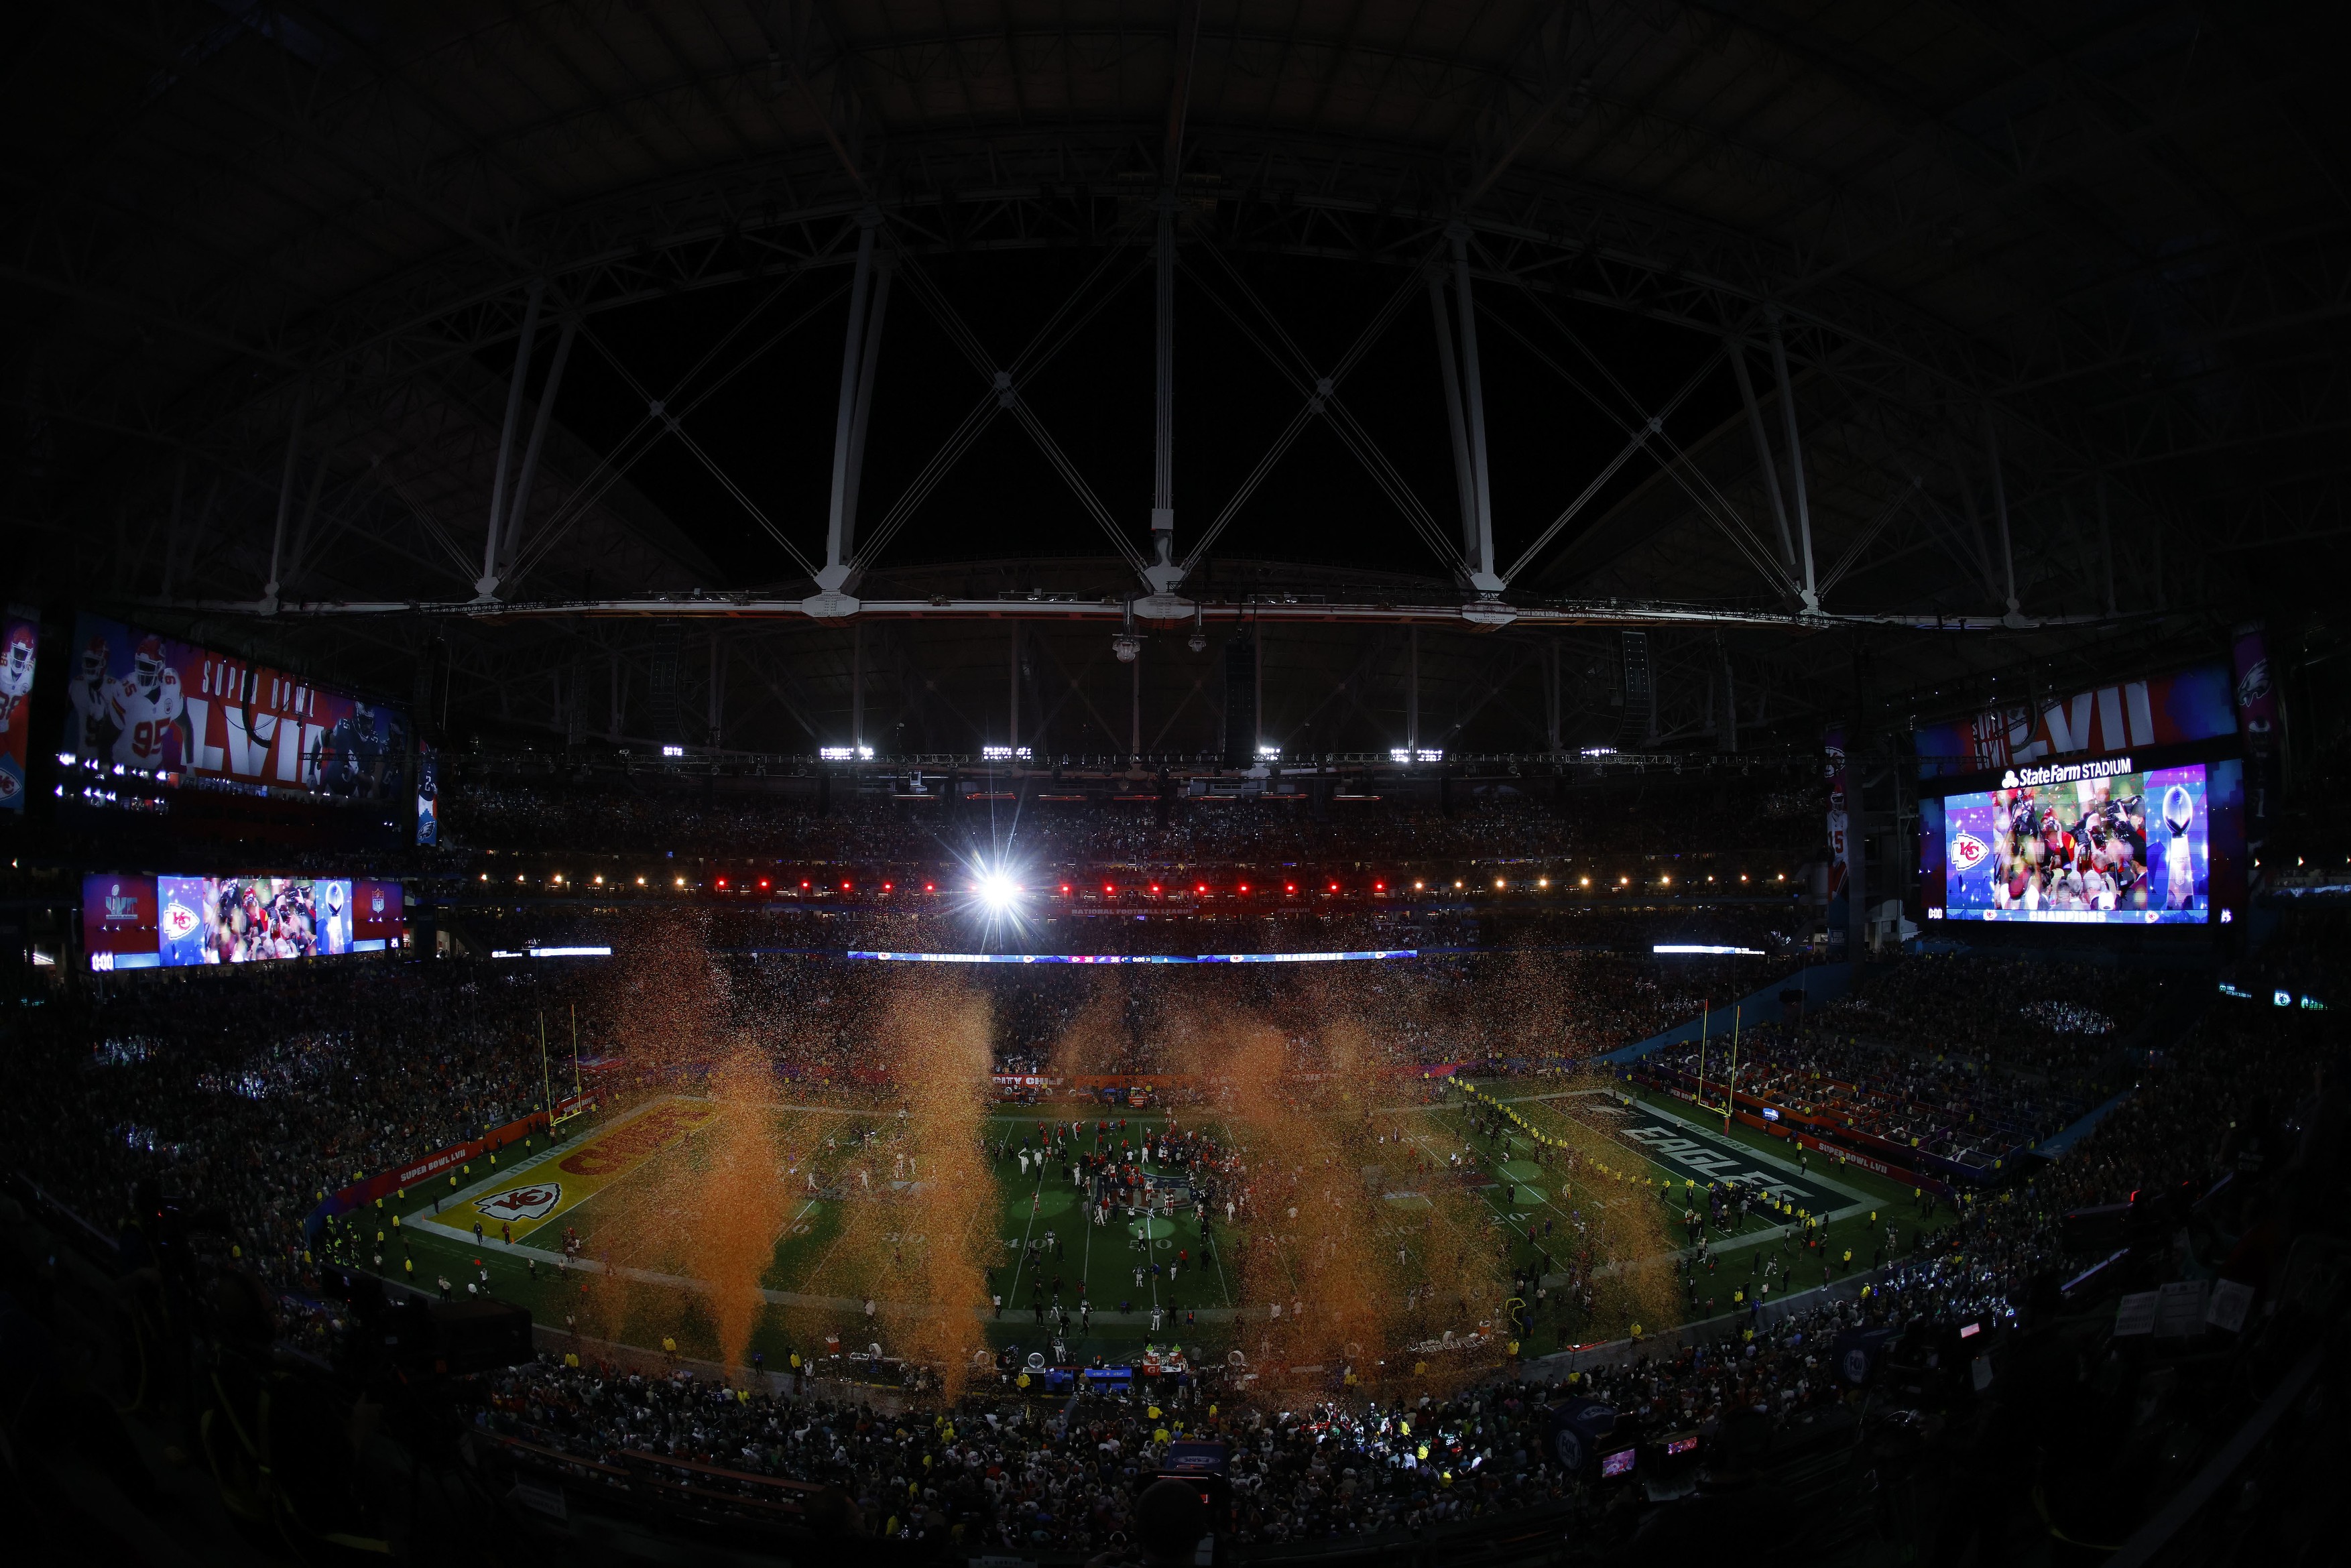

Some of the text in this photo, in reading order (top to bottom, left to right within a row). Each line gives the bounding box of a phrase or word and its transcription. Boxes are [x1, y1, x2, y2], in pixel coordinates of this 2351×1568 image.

[271, 678, 314, 717] BOWL
[2006, 680, 2155, 765] LVII
[180, 696, 325, 786] LVII
[2082, 757, 2132, 779] STADIUM
[1960, 841, 1979, 861] KC
[172, 912, 191, 930] KC
[2029, 910, 2106, 922] CHAMPIONS
[92, 951, 114, 971] 0:00
[992, 1077, 1022, 1085] CITY
[1681, 1091, 1693, 1102] BOW
[400, 1149, 466, 1182] SUPER BOWL LVII
[1819, 1142, 1888, 1174] SUPER BOWL LVII
[493, 1189, 553, 1211] KC
[1490, 1212, 1527, 1225] 20
